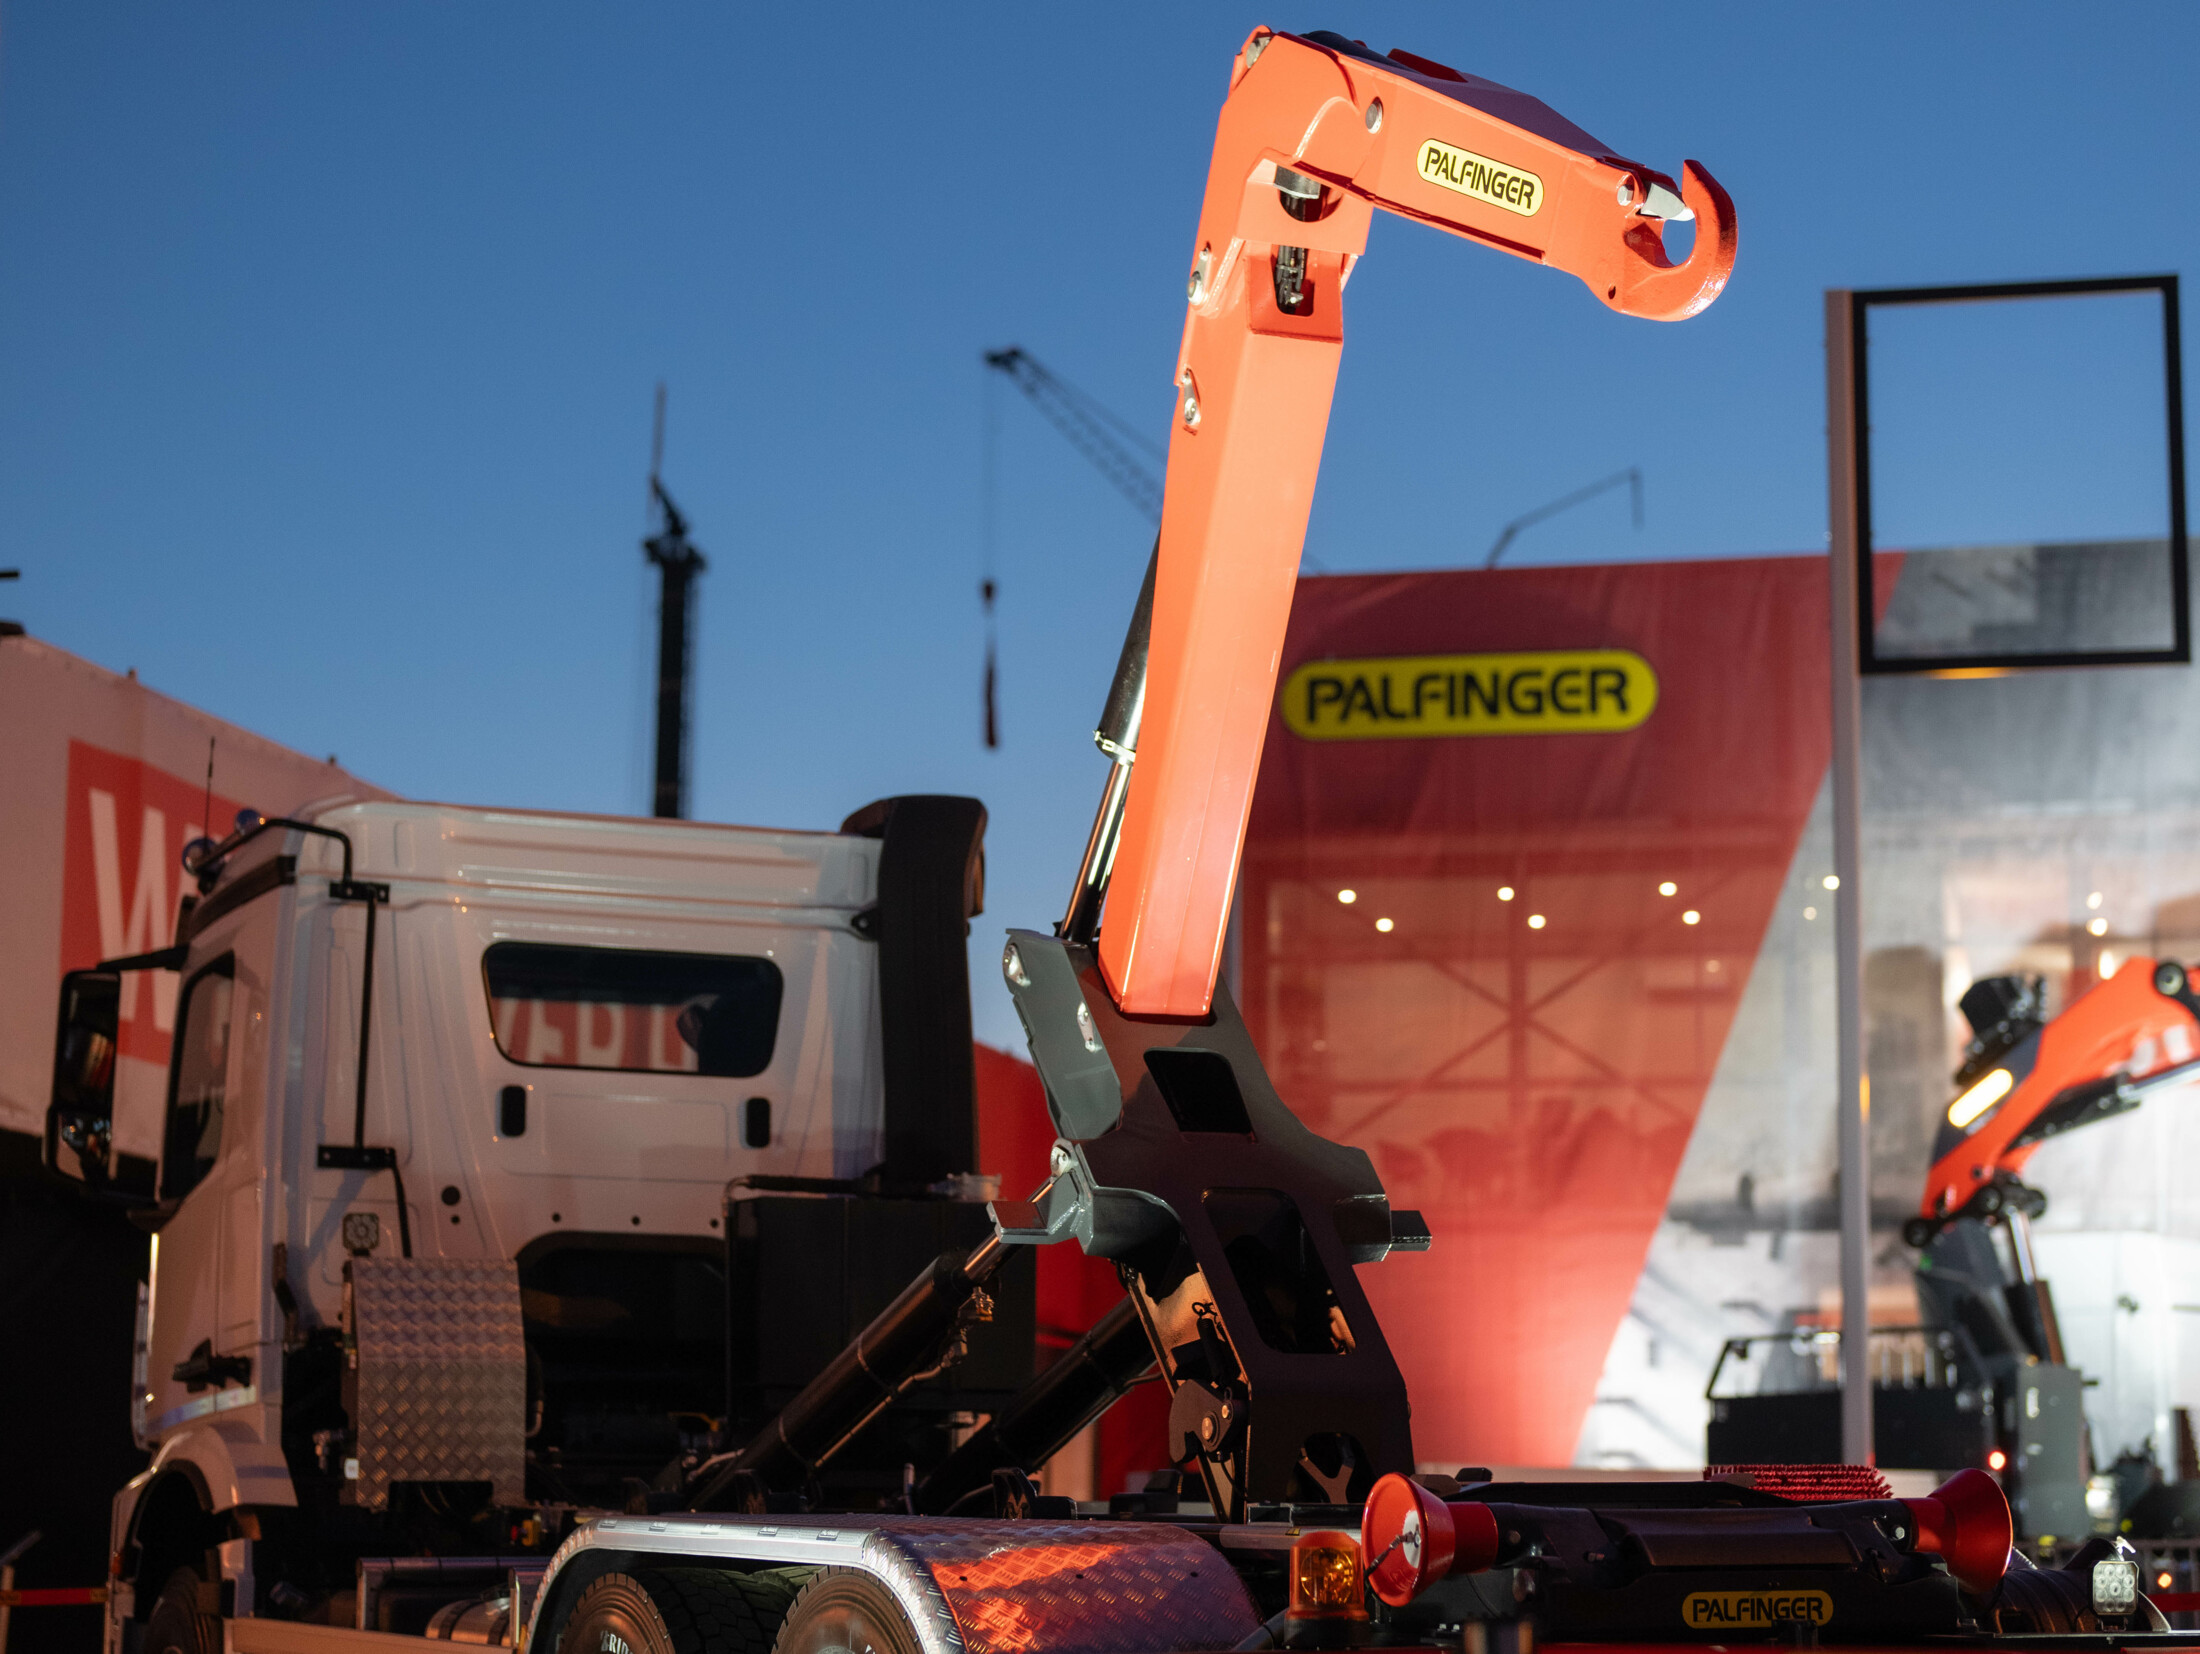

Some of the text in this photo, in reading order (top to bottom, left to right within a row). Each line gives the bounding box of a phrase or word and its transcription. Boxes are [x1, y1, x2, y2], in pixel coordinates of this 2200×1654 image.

[1424, 146, 1535, 210] PALFINGER
[1307, 667, 1628, 723] PALFINGER
[1692, 1596, 1824, 1622] PALFINGER
